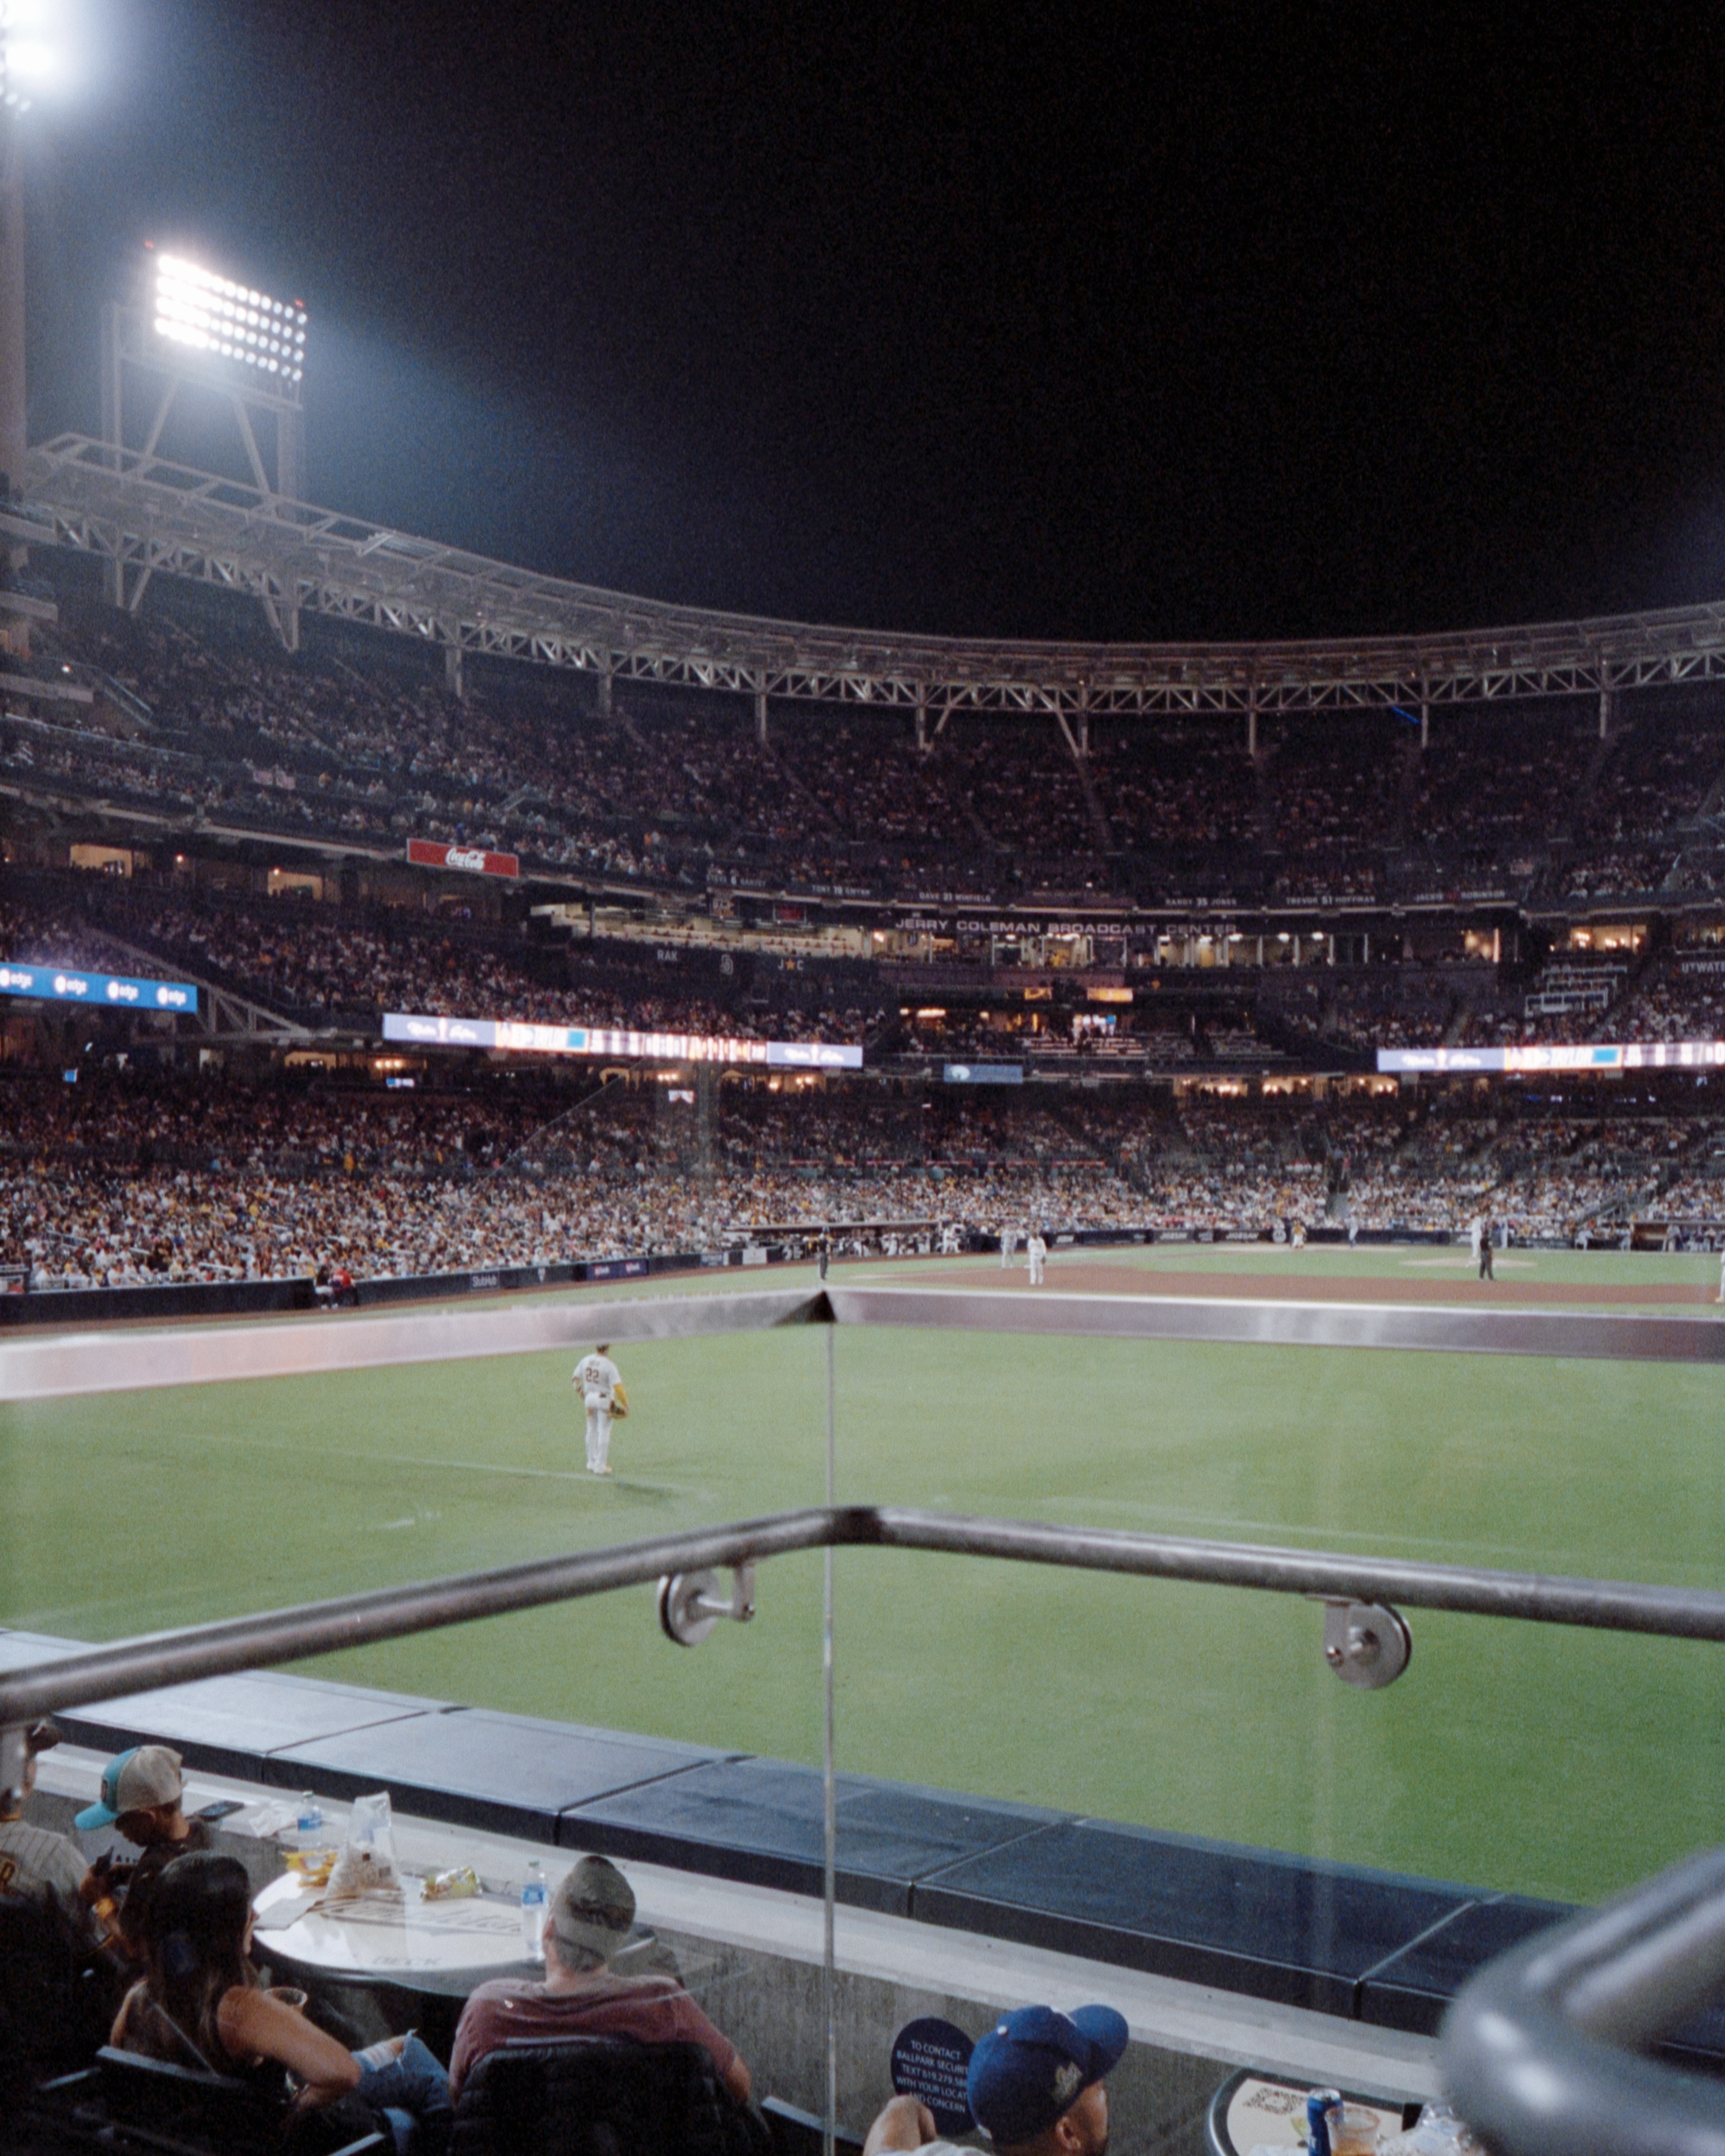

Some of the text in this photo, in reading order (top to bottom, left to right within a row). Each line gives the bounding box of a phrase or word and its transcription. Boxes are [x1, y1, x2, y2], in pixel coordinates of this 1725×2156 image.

[919, 891, 939, 900] DAVE
[955, 893, 991, 902] WINFIELD
[1165, 898, 1193, 906] RANDY
[1211, 898, 1237, 906] JONES
[1286, 896, 1318, 905] TREVOR
[1335, 895, 1376, 904] HOFFMAN
[896, 919, 1237, 934] JERRY COLEMAN BROADCAST CENTER
[657, 949, 678, 961] RAK
[1681, 960, 1725, 973] UTWATE
[10, 973, 33, 989] edge
[66, 979, 87, 995] edge
[119, 985, 138, 1000] edge
[168, 991, 186, 1005] edge
[1550, 1047, 1593, 1067] TAYLOR
[472, 1275, 497, 1288] StubHub
[585, 1367, 599, 1384] 22
[911, 2040, 961, 2060] TO CONTACT
[896, 2049, 968, 2075] BALLPARK SECURIT
[902, 2063, 920, 2076] TEXT
[896, 2076, 967, 2101] WITH YOUR LOCAT
[927, 2096, 965, 2113] CONCERN
